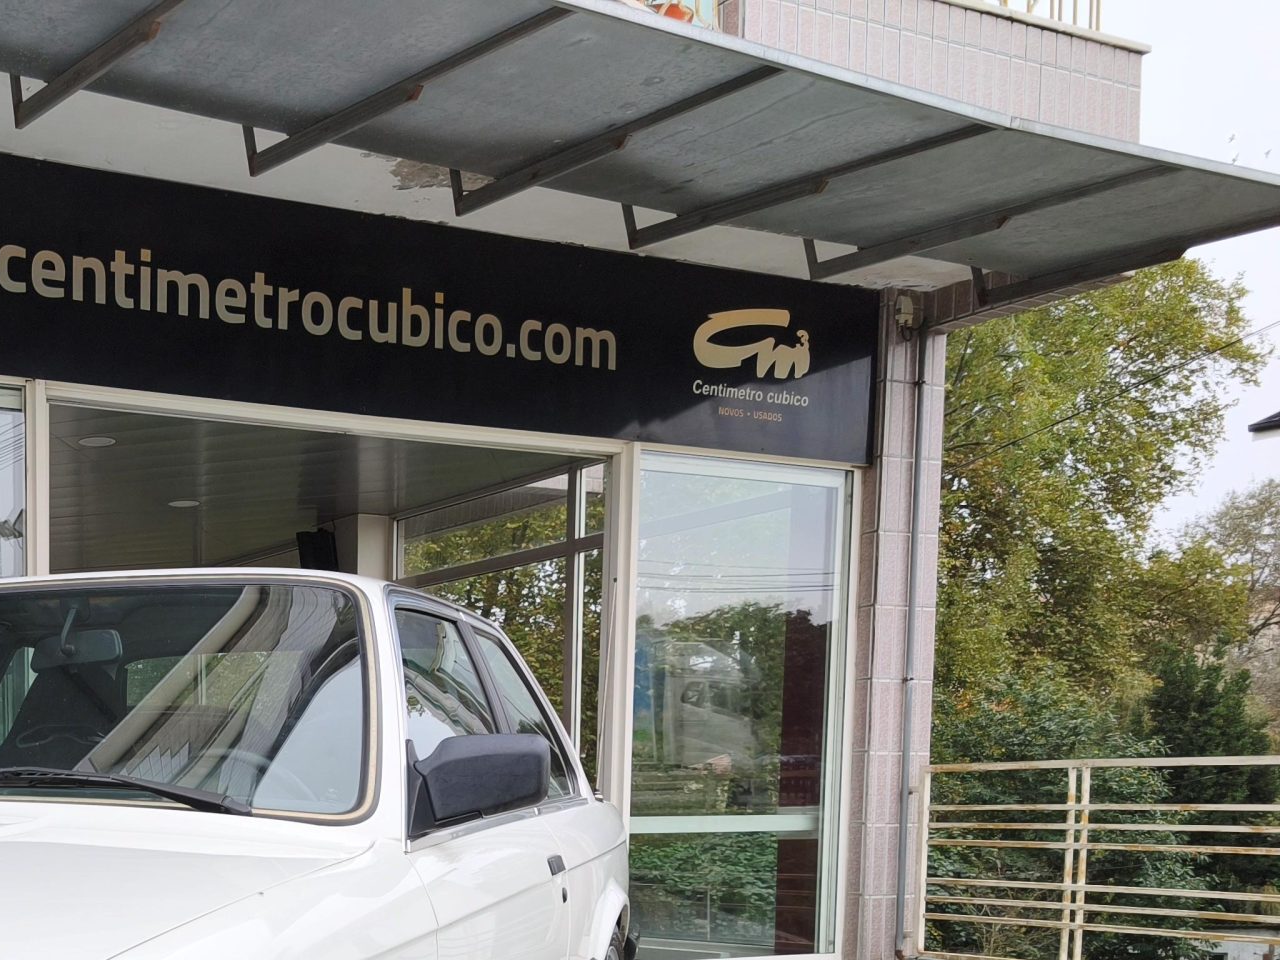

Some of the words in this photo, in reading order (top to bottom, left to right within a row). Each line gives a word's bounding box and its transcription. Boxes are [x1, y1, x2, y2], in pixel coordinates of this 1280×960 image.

[692, 379, 763, 402] Centimetro
[766, 390, 809, 407] cubico
[718, 407, 744, 417] NOVOS
[753, 410, 783, 422] USADOS
